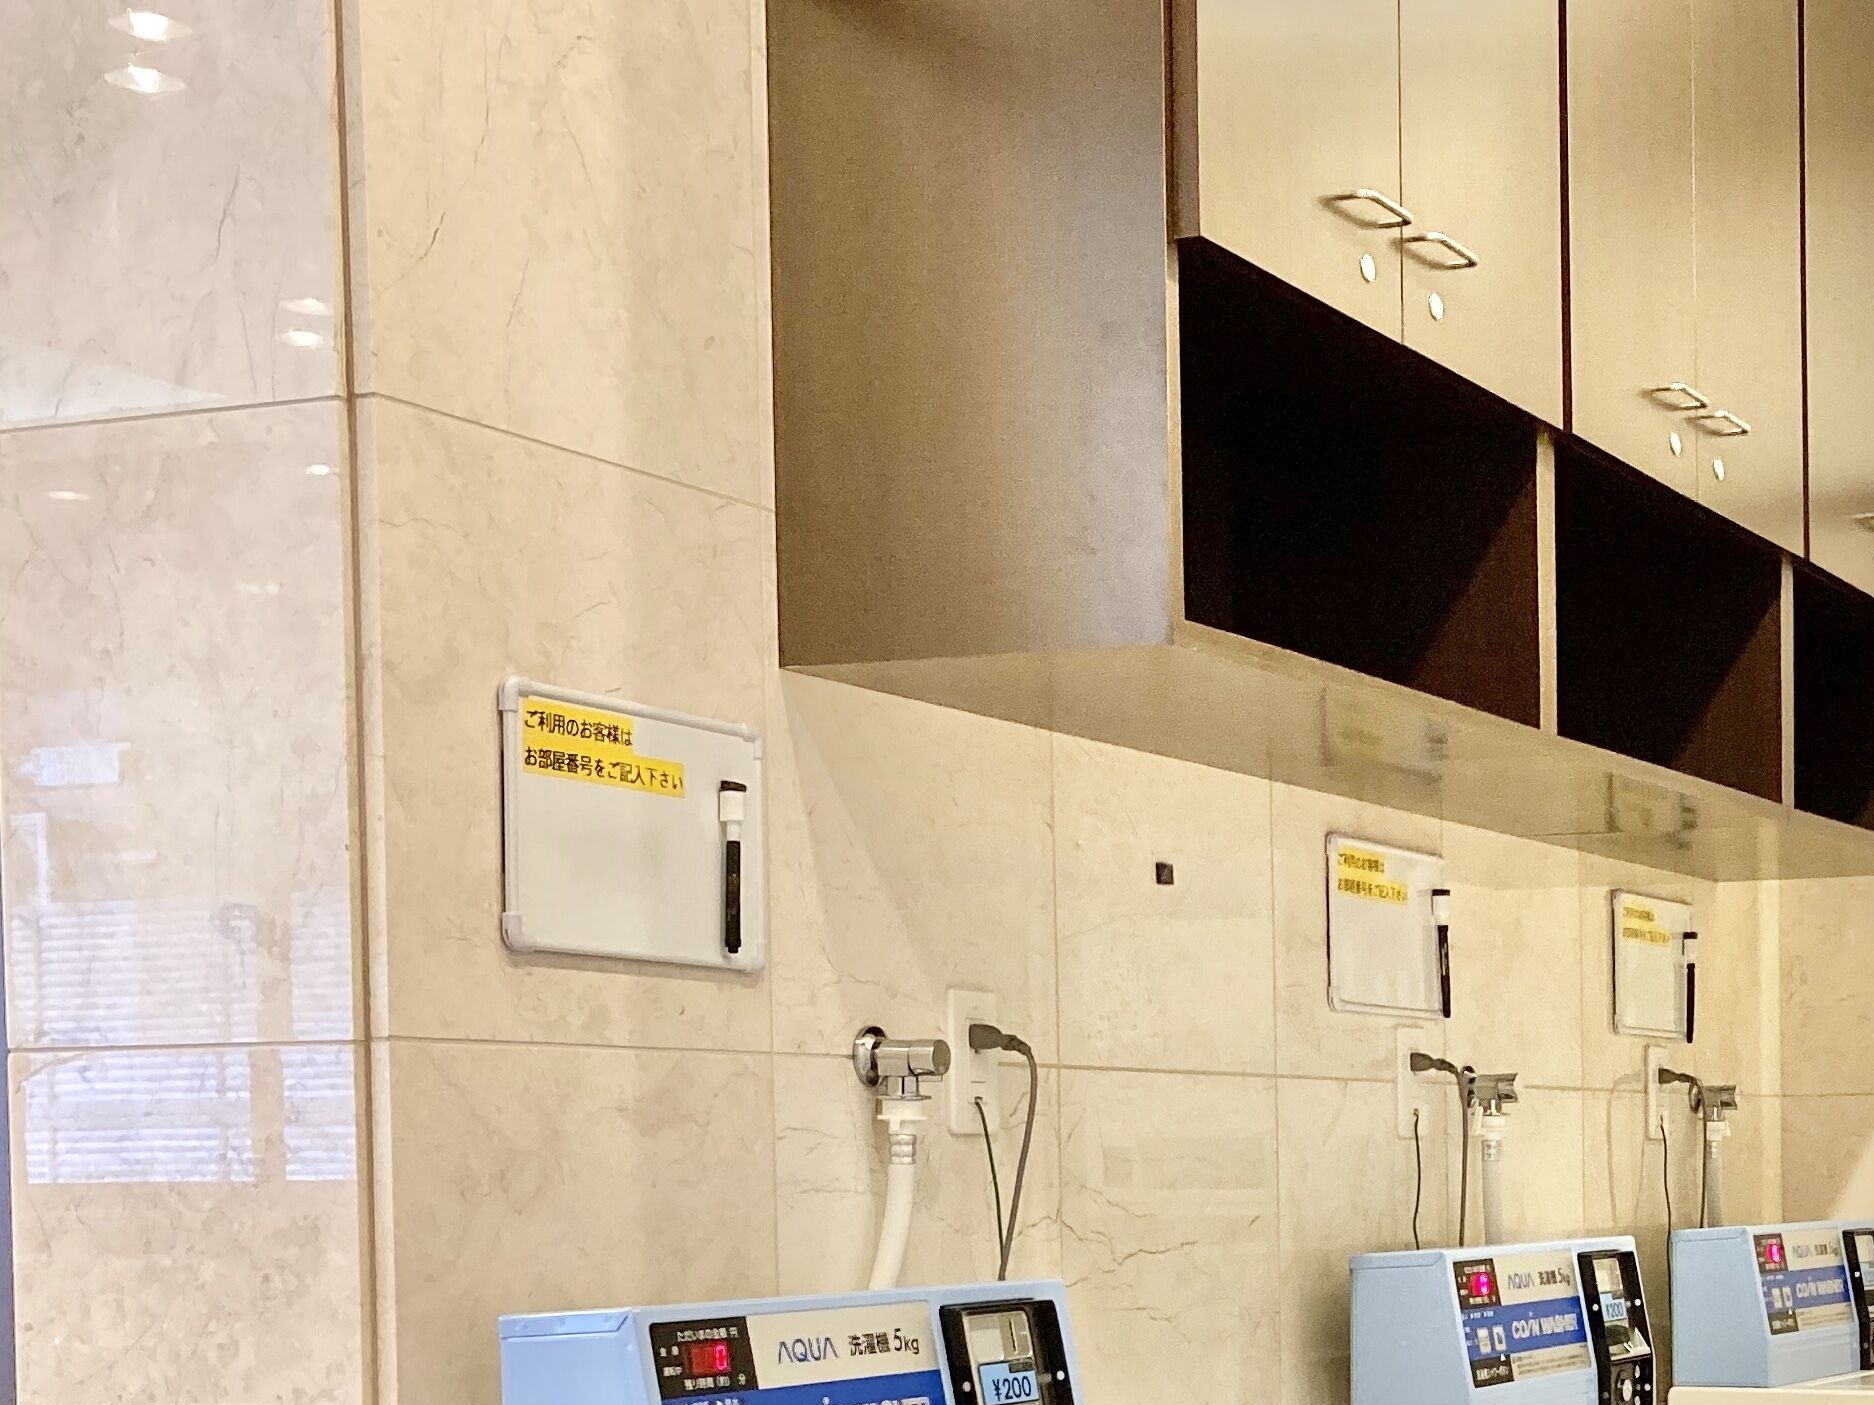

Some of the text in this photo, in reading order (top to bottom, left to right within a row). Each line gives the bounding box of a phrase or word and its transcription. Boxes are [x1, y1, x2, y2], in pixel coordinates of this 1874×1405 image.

[524, 709, 633, 747] ご利用のお客様は
[524, 746, 684, 791] お部屋番号をご記入下さい
[778, 1327, 920, 1365] AQUA 洗濯機 5kg
[992, 1375, 1033, 1402] ¥200
